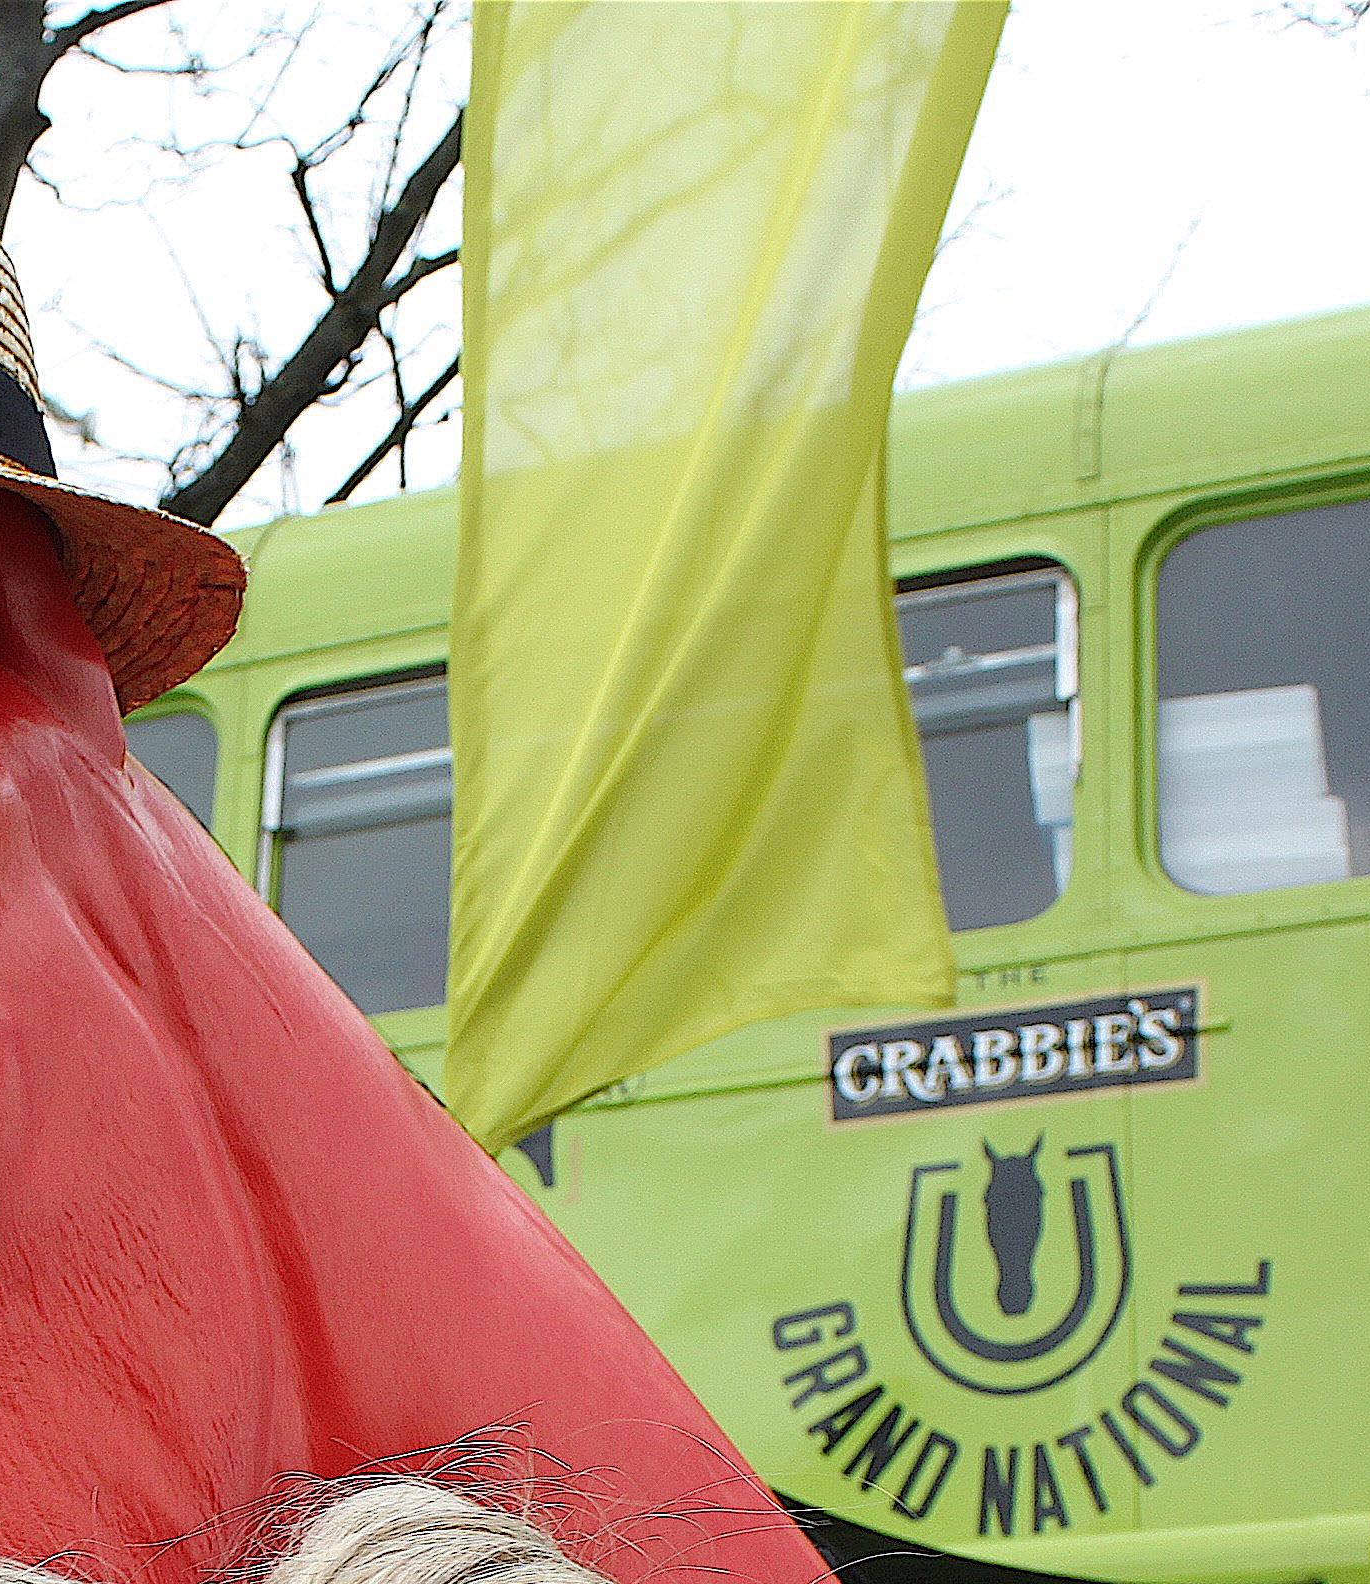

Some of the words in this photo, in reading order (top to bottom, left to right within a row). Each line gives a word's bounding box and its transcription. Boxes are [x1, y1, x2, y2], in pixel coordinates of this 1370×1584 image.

[833, 997, 1183, 1102] CRABBIE'S
[772, 1301, 959, 1520] GRAND
[977, 1259, 1271, 1537] NATIONAL
